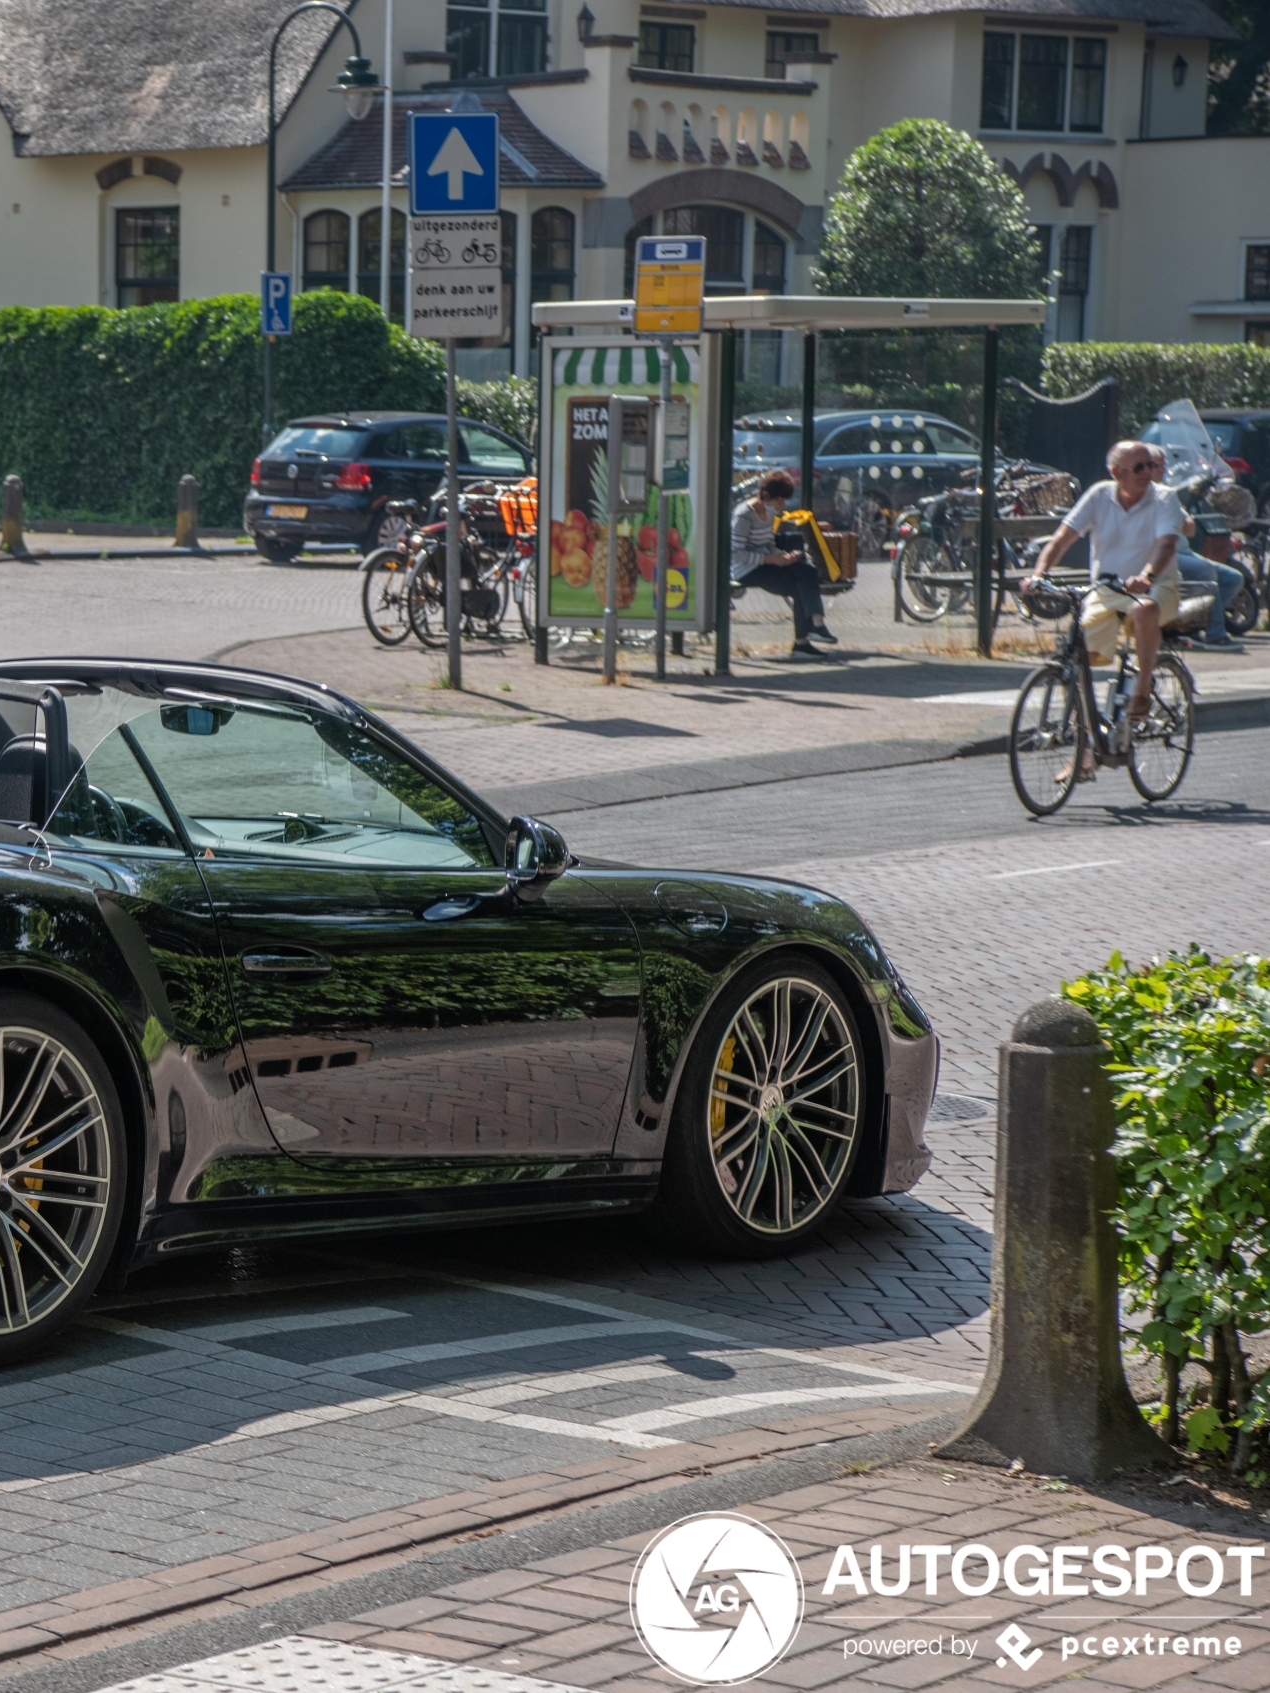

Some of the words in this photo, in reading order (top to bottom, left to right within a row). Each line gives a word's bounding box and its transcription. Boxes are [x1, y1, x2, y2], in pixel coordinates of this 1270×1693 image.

[413, 219, 498, 234] uitgezonderd
[269, 278, 286, 309] P
[416, 284, 446, 296] denk
[451, 285, 473, 295] aan
[478, 284, 495, 294] uw
[413, 305, 498, 321] parkeerschijf
[573, 407, 598, 422] HET
